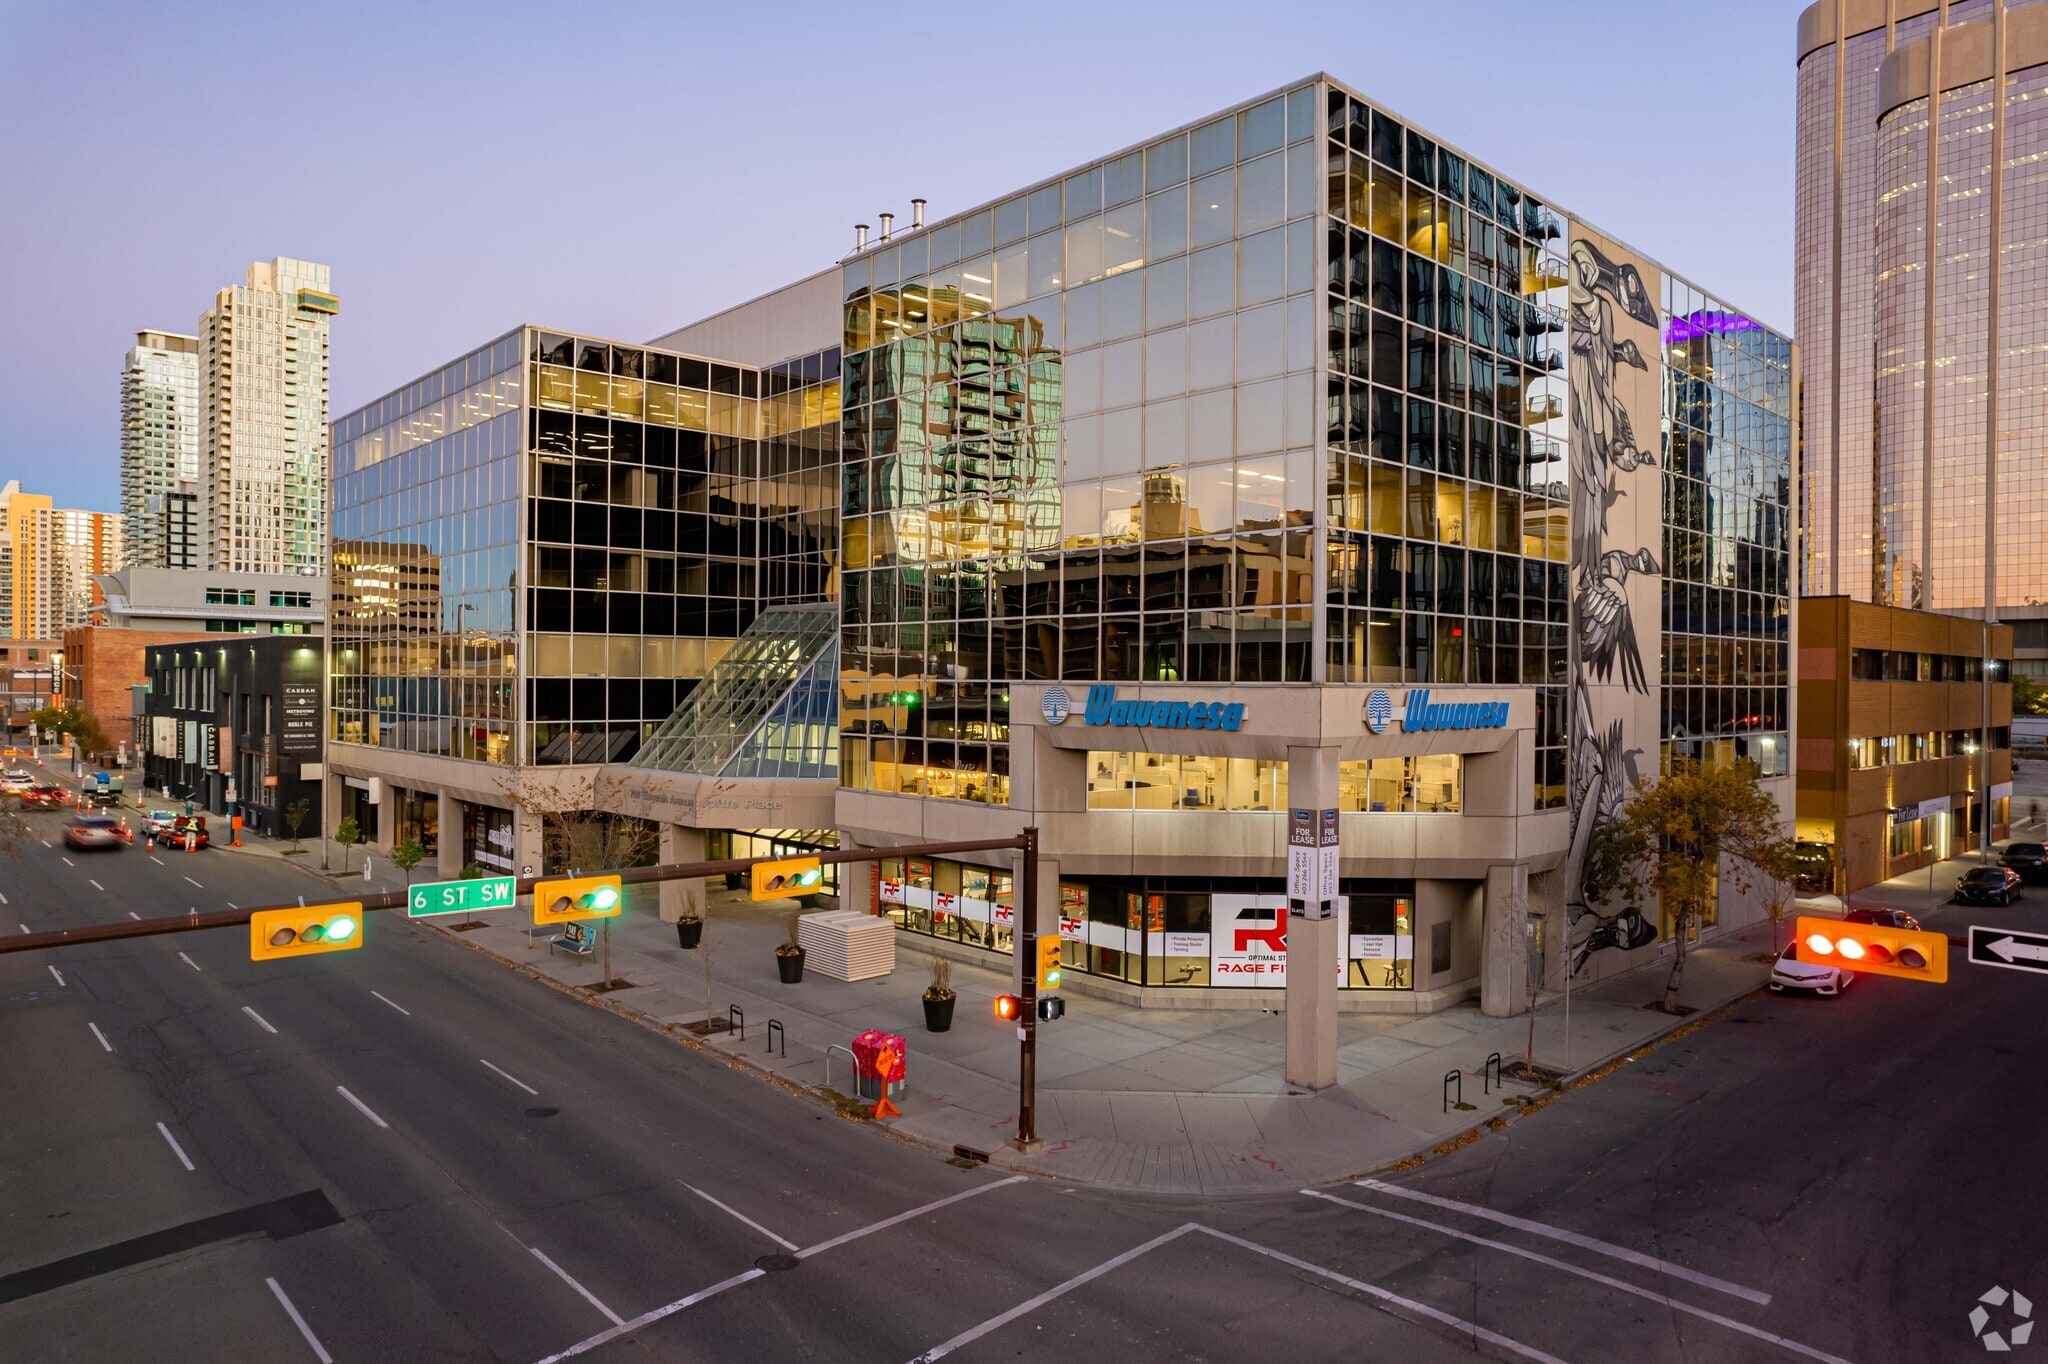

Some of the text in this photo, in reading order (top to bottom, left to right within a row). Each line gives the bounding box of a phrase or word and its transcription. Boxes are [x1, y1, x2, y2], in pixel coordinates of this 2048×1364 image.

[1083, 685, 1245, 731] Wawanesa
[1402, 689, 1510, 733] Wawanesa
[207, 726, 216, 765] CASBAH
[744, 799, 783, 810] Place
[1295, 827, 1310, 836] FOR
[1324, 827, 1335, 836] FOR
[1291, 835, 1315, 844] LEASE
[1321, 835, 1337, 844] LEASE
[414, 882, 509, 909] 6 ST SW
[1217, 963, 1265, 973] RAGE
